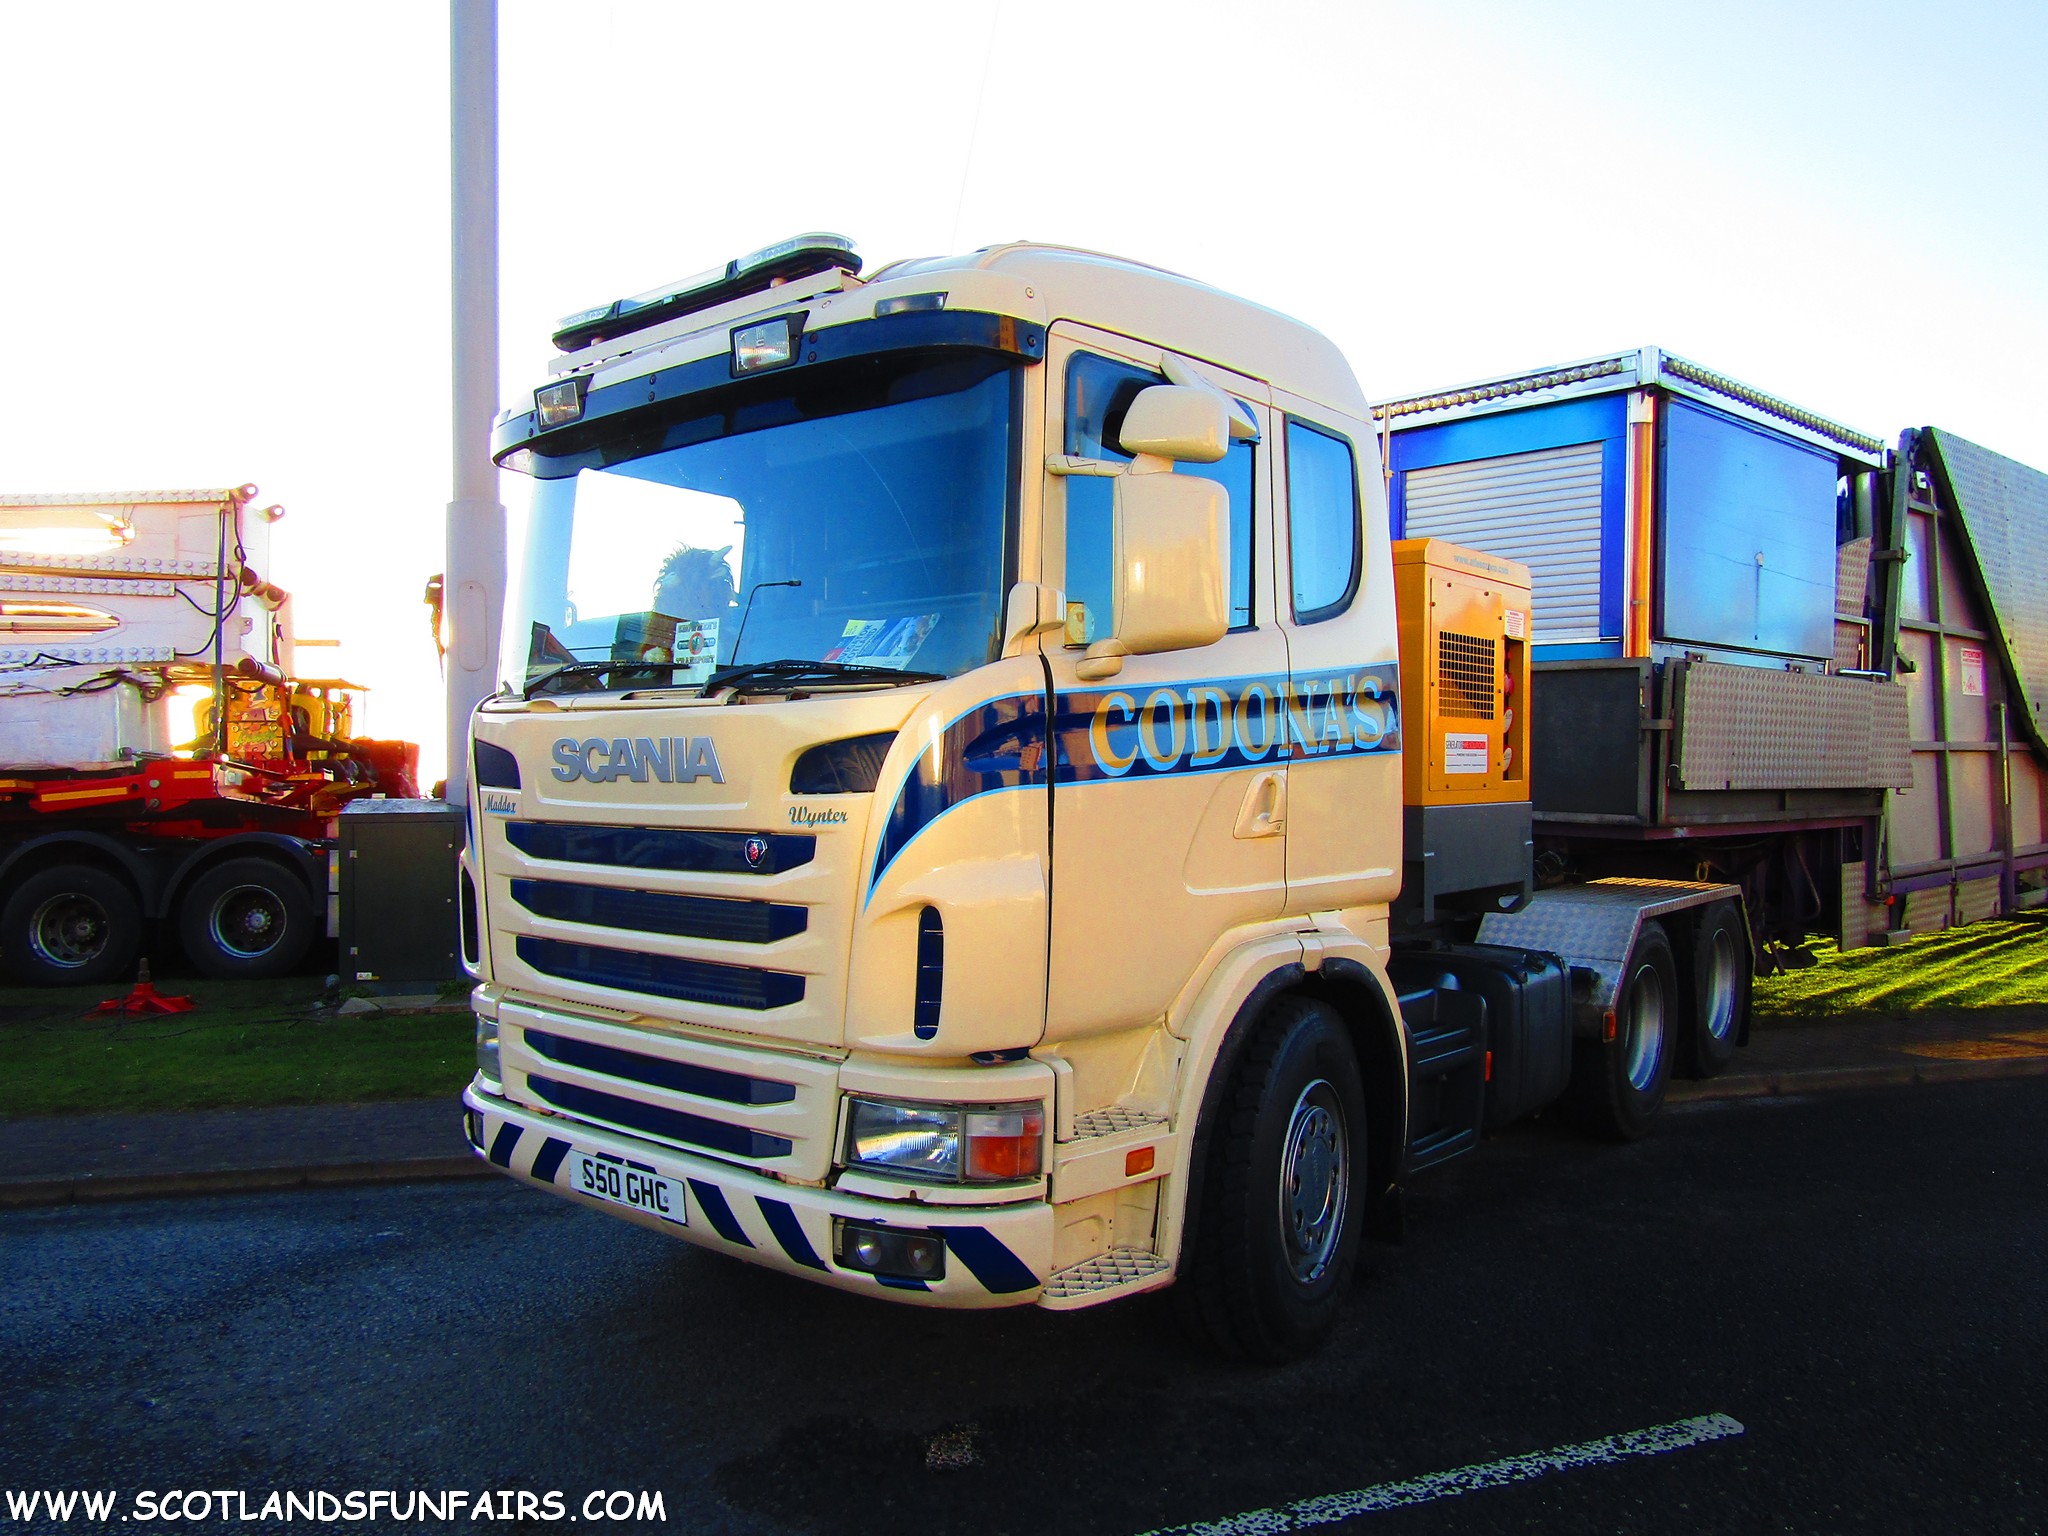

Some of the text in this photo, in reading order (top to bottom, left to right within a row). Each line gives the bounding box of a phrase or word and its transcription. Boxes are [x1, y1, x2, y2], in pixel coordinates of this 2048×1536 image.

[1089, 674, 1386, 777] CODONA'S
[551, 736, 726, 783] SCANIA
[485, 794, 517, 814] Maddox
[788, 806, 849, 828] Wynter
[582, 1158, 670, 1213] S50 GHC
